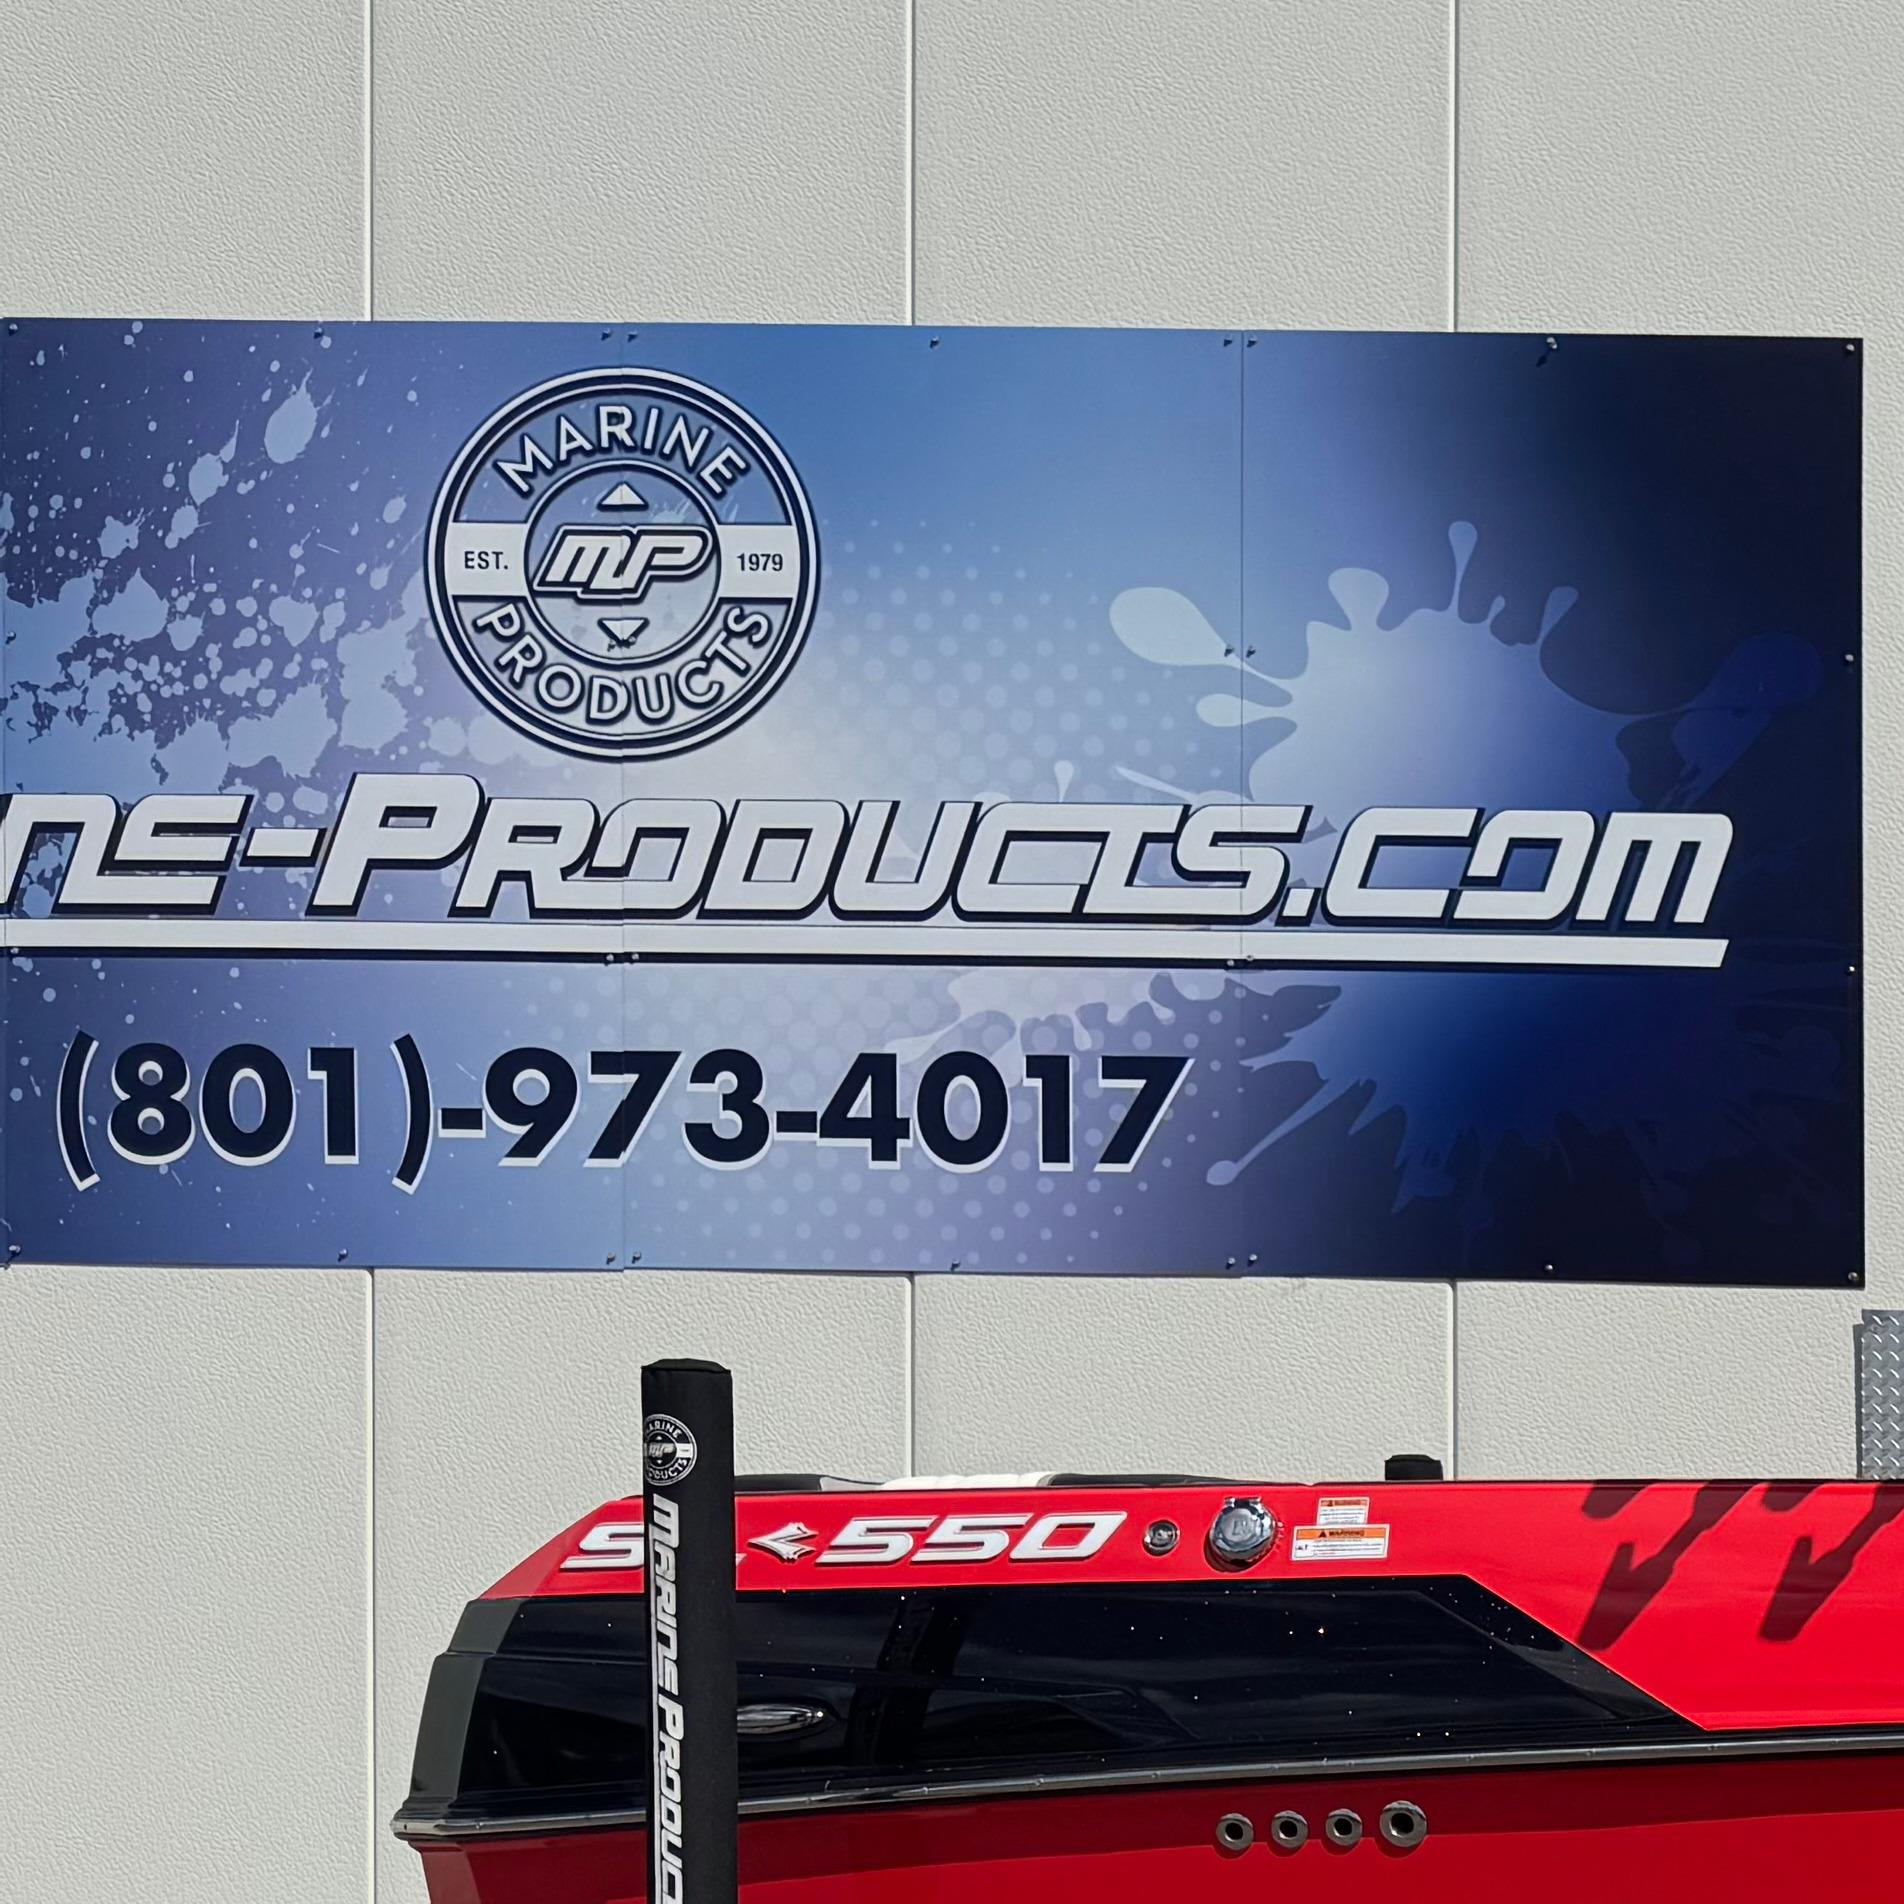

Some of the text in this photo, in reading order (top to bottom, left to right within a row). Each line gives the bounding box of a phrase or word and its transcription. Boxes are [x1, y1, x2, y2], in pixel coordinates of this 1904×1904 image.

[496, 402, 752, 498] MARINE
[462, 549, 510, 573] EST.
[735, 550, 785, 574] 1979
[474, 602, 776, 726] PRODUCTS
[56, 1028, 1197, 1196] (801)-973-4017
[814, 1510, 1129, 1566] 550
[652, 1493, 681, 1696] MARINE
